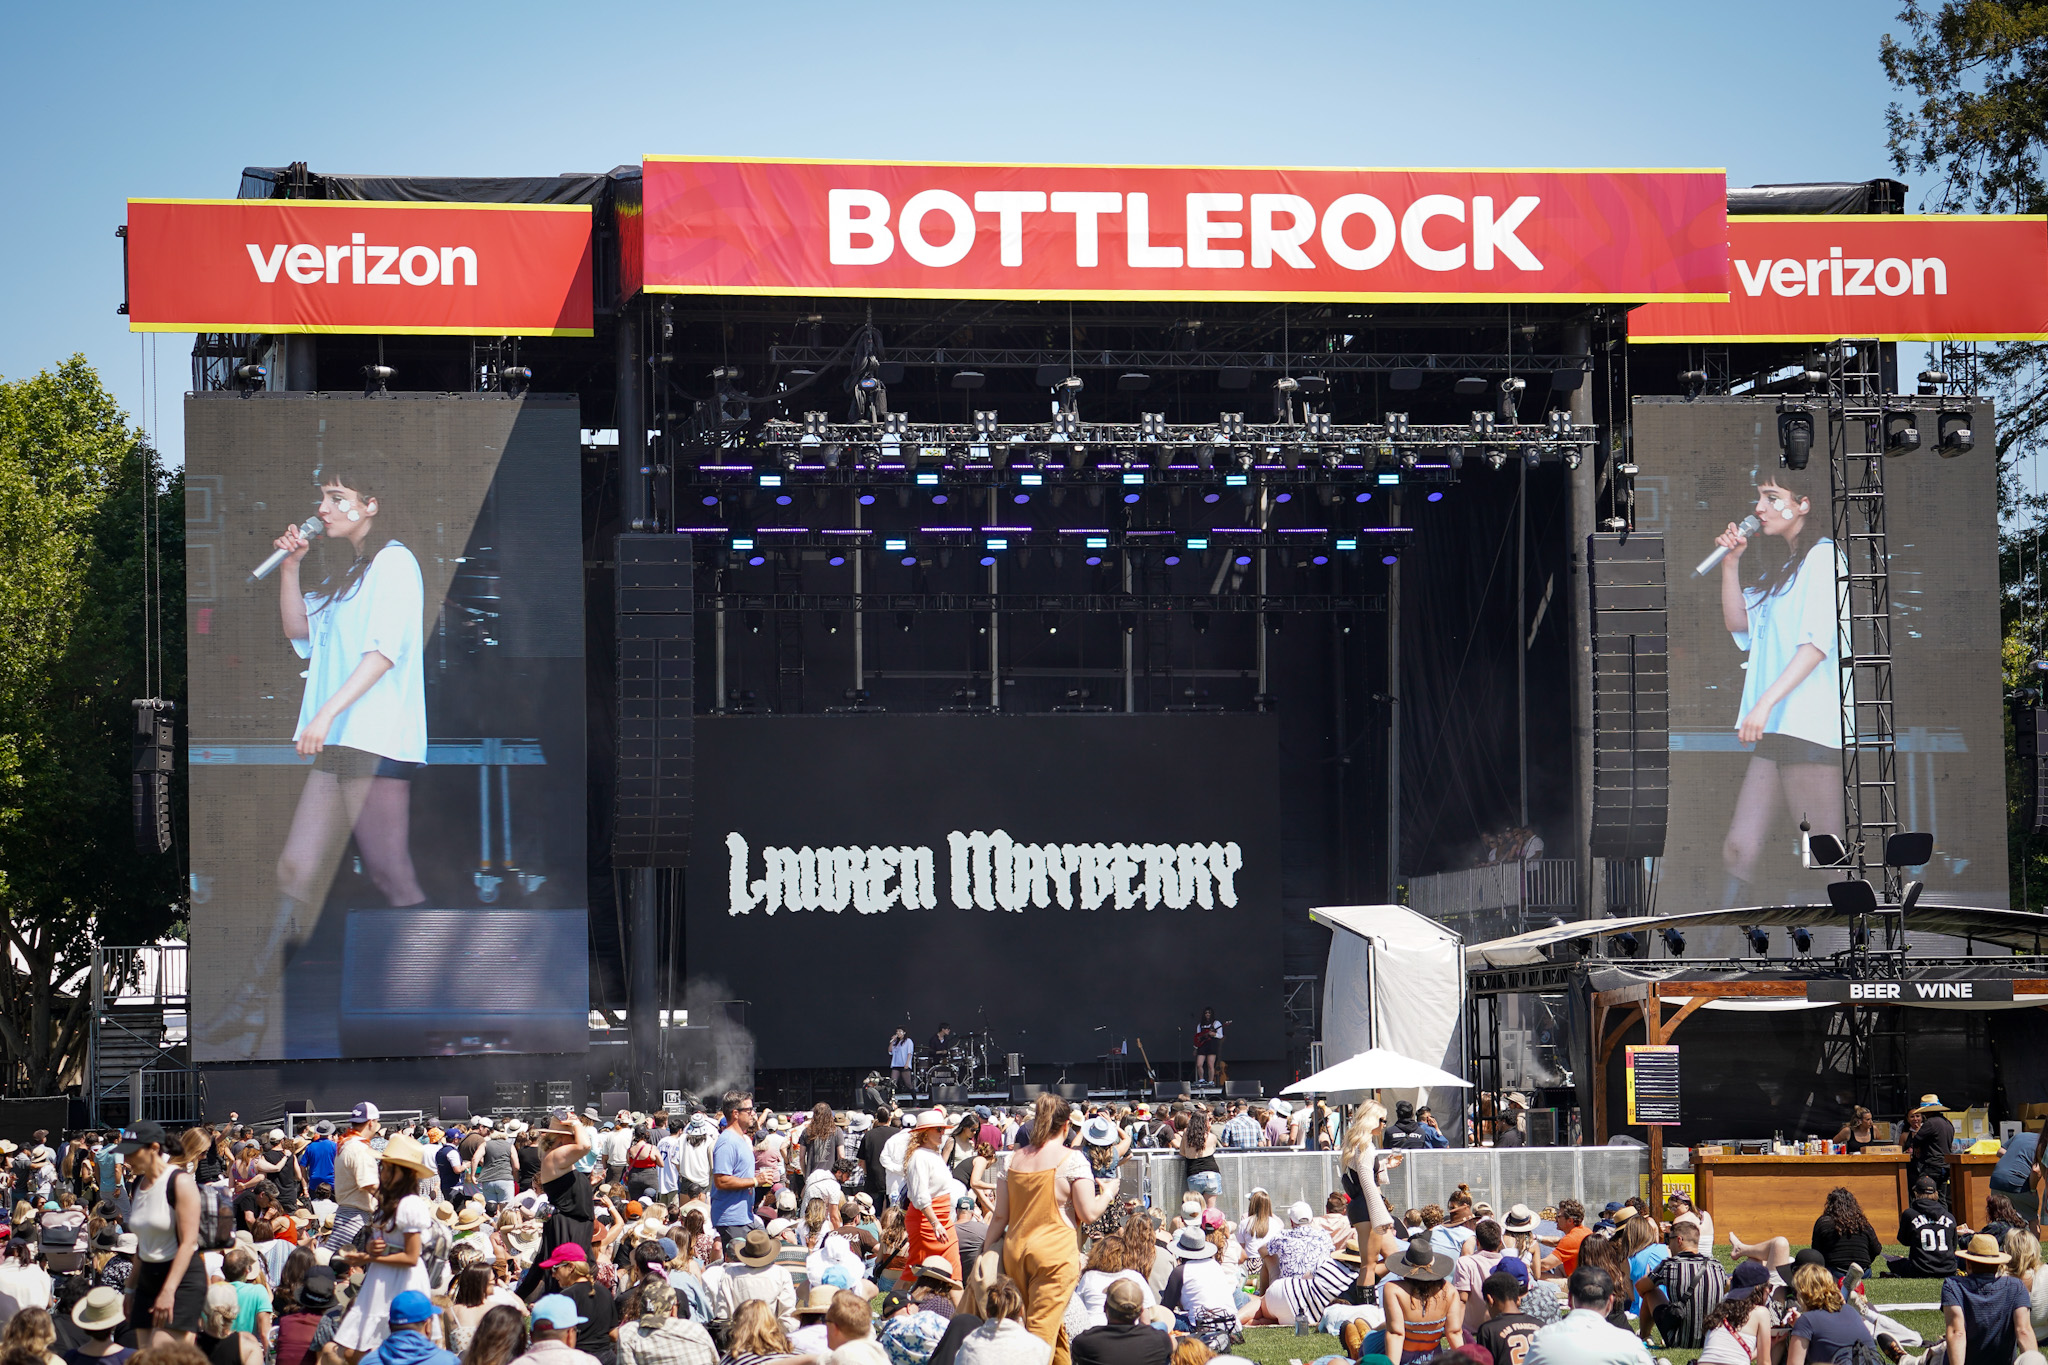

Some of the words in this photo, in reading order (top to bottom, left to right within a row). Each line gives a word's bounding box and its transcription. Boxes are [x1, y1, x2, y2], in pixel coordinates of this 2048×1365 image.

[828, 188, 1544, 272] BOTTLEROCK
[246, 233, 477, 286] verizon
[1734, 247, 1948, 297] verizon
[1849, 983, 1901, 999] BEER
[1915, 983, 1973, 999] WINE
[1920, 1228, 1949, 1252] 01
